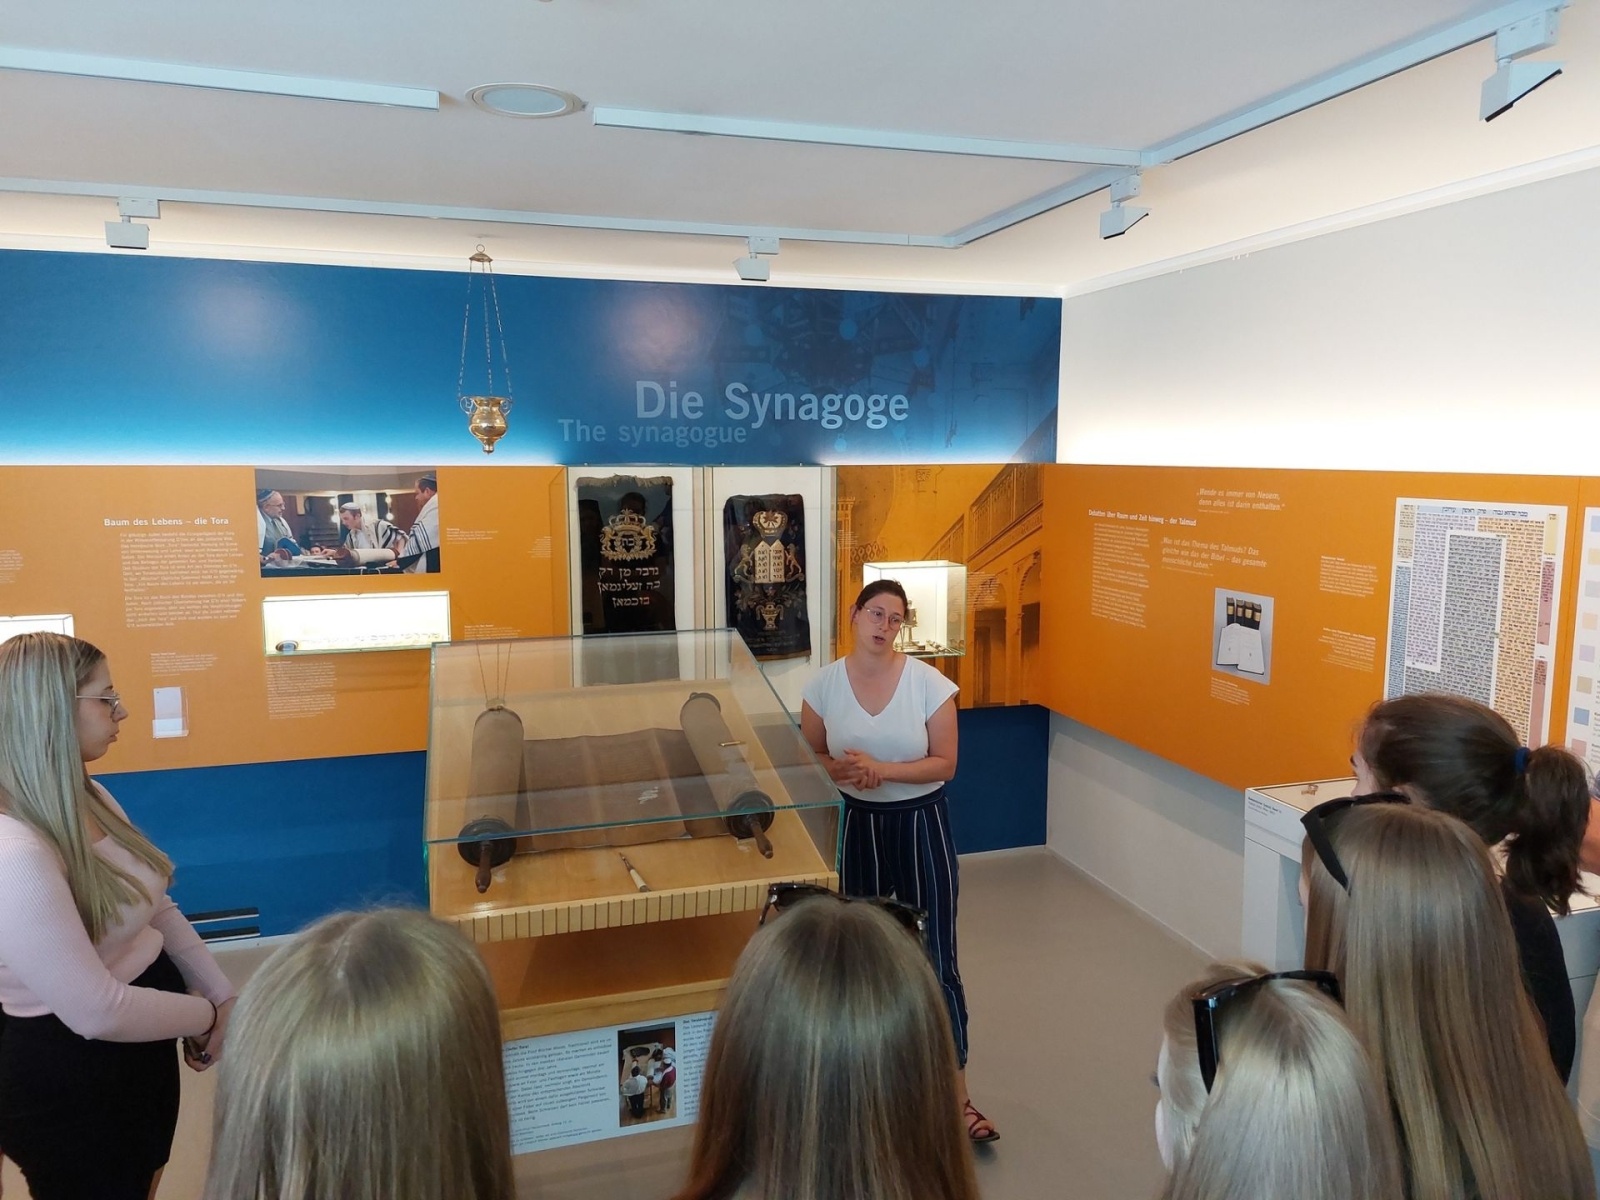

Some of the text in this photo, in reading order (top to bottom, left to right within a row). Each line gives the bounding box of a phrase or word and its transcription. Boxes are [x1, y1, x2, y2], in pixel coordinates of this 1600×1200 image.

[636, 381, 909, 429] Die Synagoge
[558, 419, 747, 448] The synagogue
[1179, 518, 1196, 526] Talmud
[1248, 547, 1259, 555] Das
